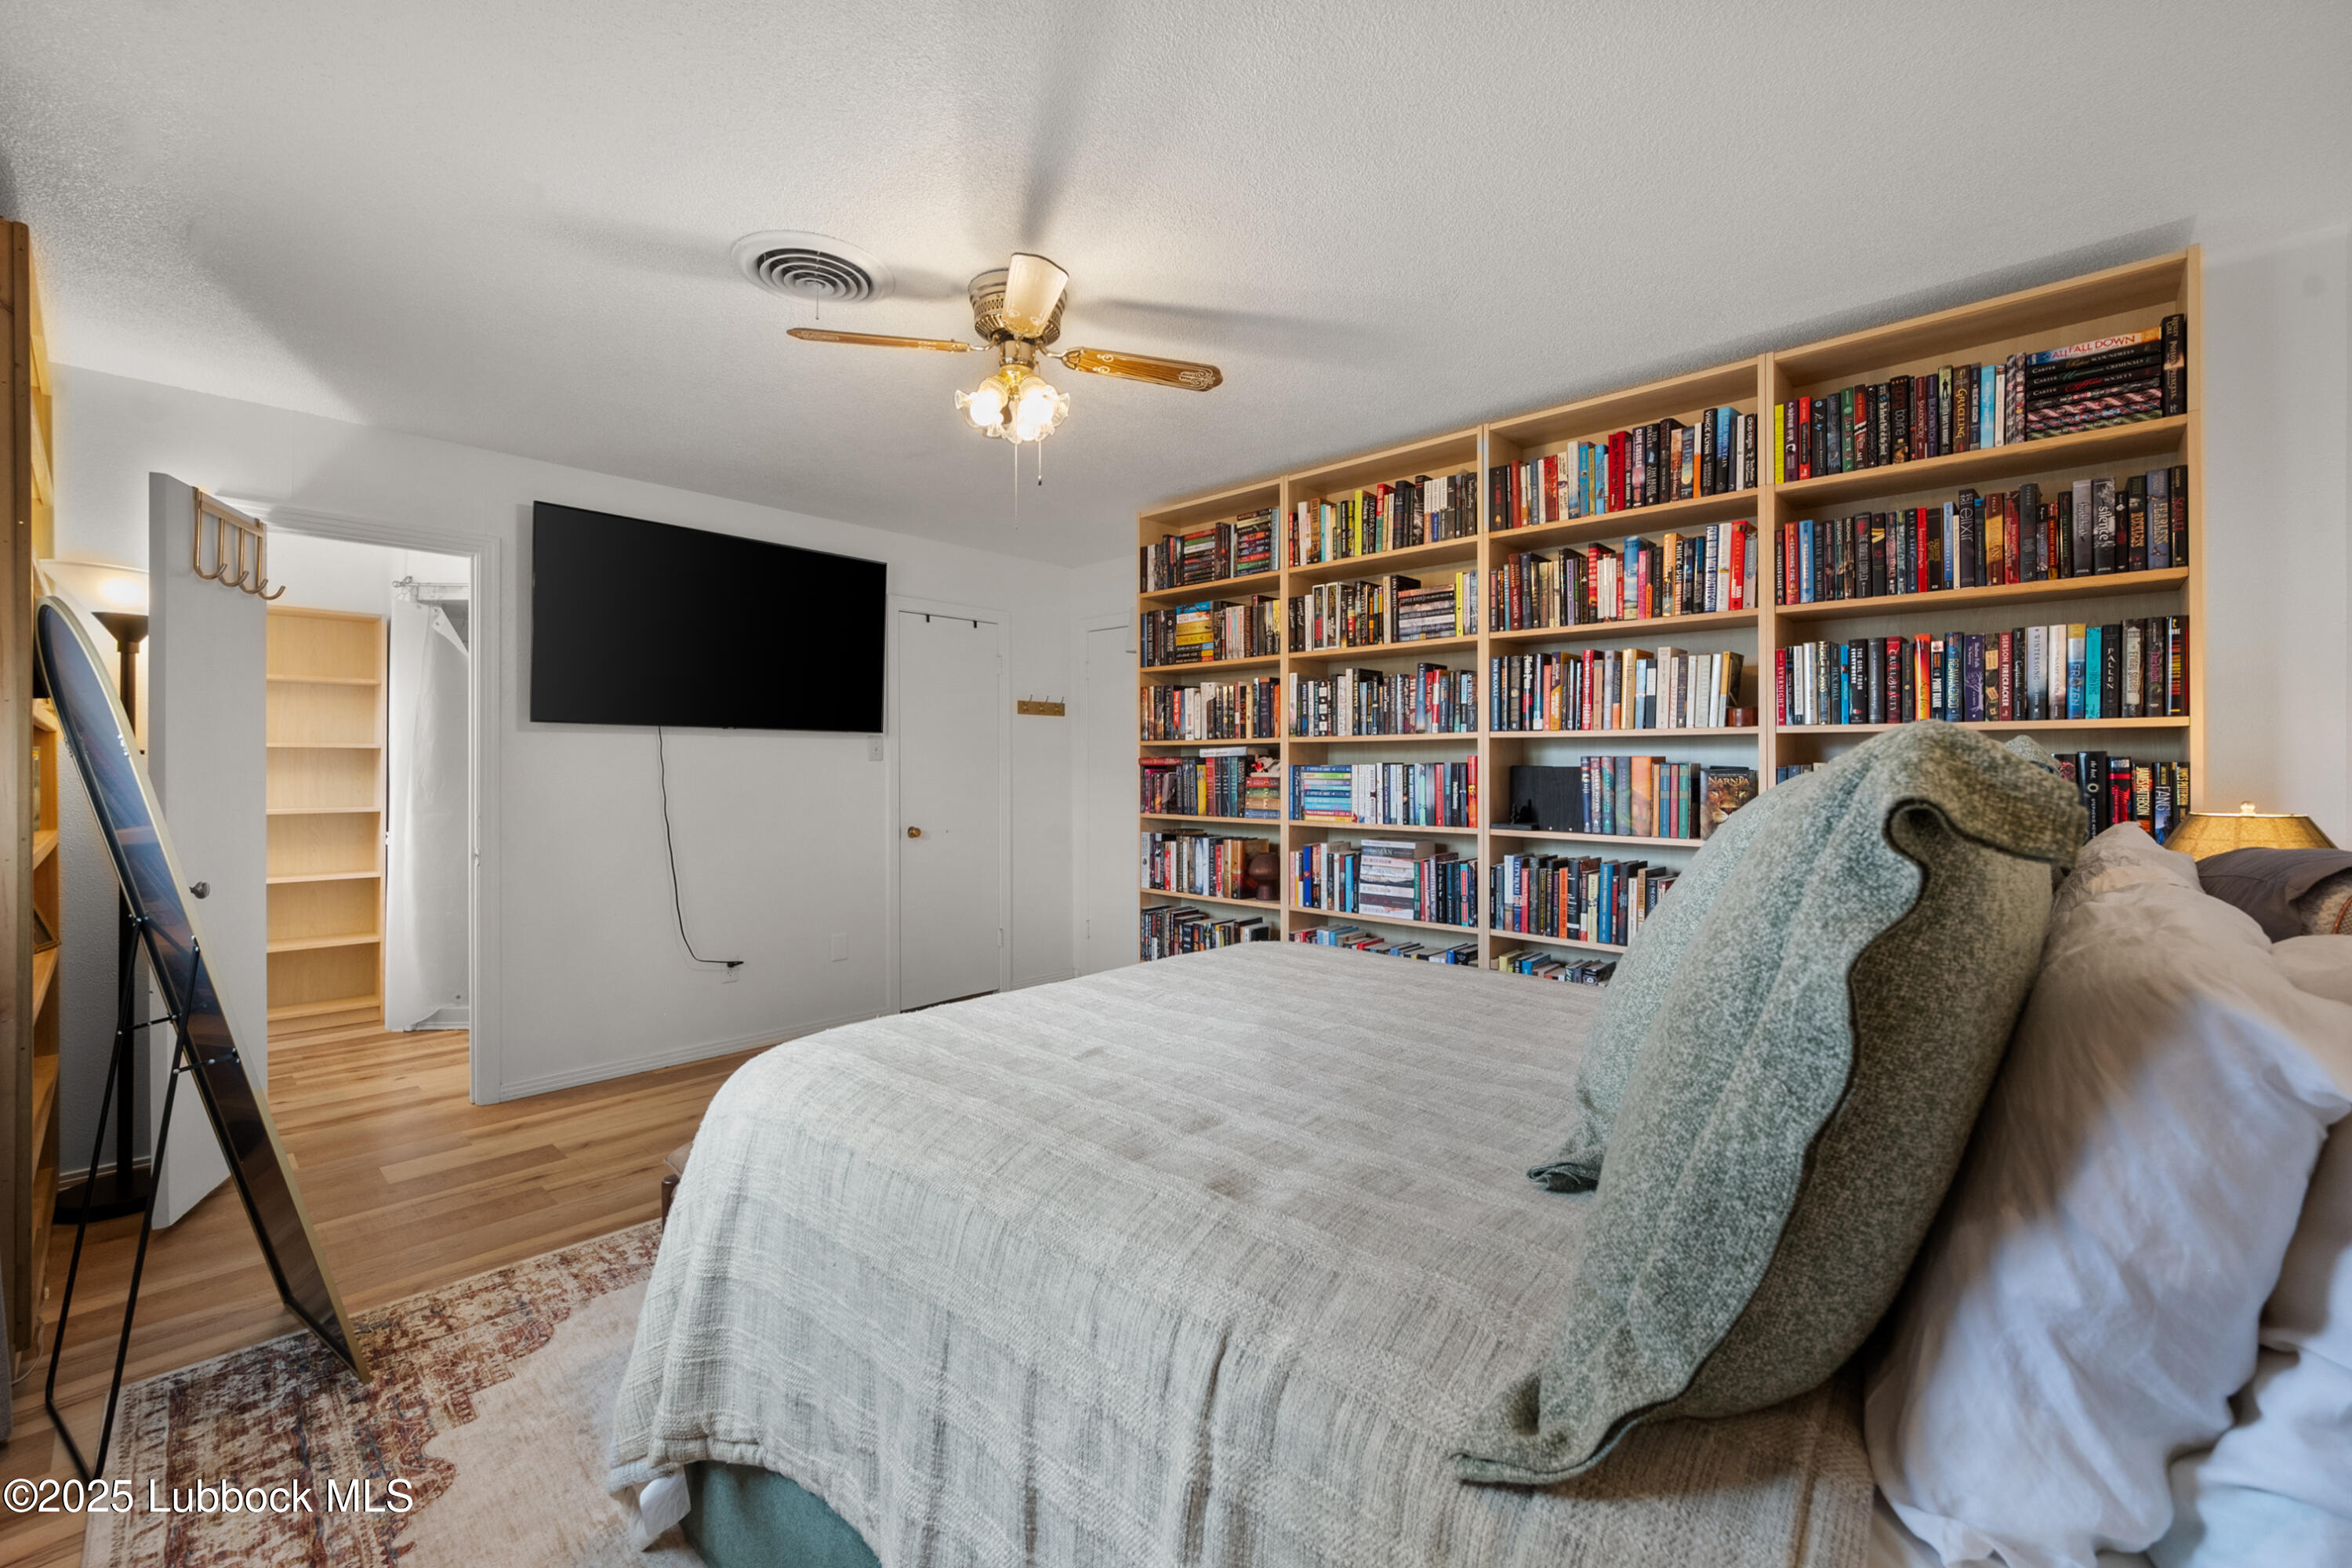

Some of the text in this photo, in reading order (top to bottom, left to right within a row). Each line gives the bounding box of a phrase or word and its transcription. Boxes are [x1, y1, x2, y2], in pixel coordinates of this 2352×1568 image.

[2094, 336, 2136, 350] DOWN
[1894, 409, 1907, 436] bovine
[1955, 388, 1967, 439] GRACELING
[1959, 507, 1973, 542] elixir
[2098, 506, 2113, 541] silence
[2130, 511, 2144, 547] RECKLESS
[2154, 503, 2169, 545] FEARLESS
[2172, 497, 2185, 532] SCARLET
[1707, 526, 1717, 541] FOUR
[1888, 649, 1897, 711] CRUEL BEAUTY
[1708, 775, 1750, 786] NARNIA
[2136, 767, 2150, 815] JAMES PATTERSON
[2155, 786, 2171, 811] FANG
